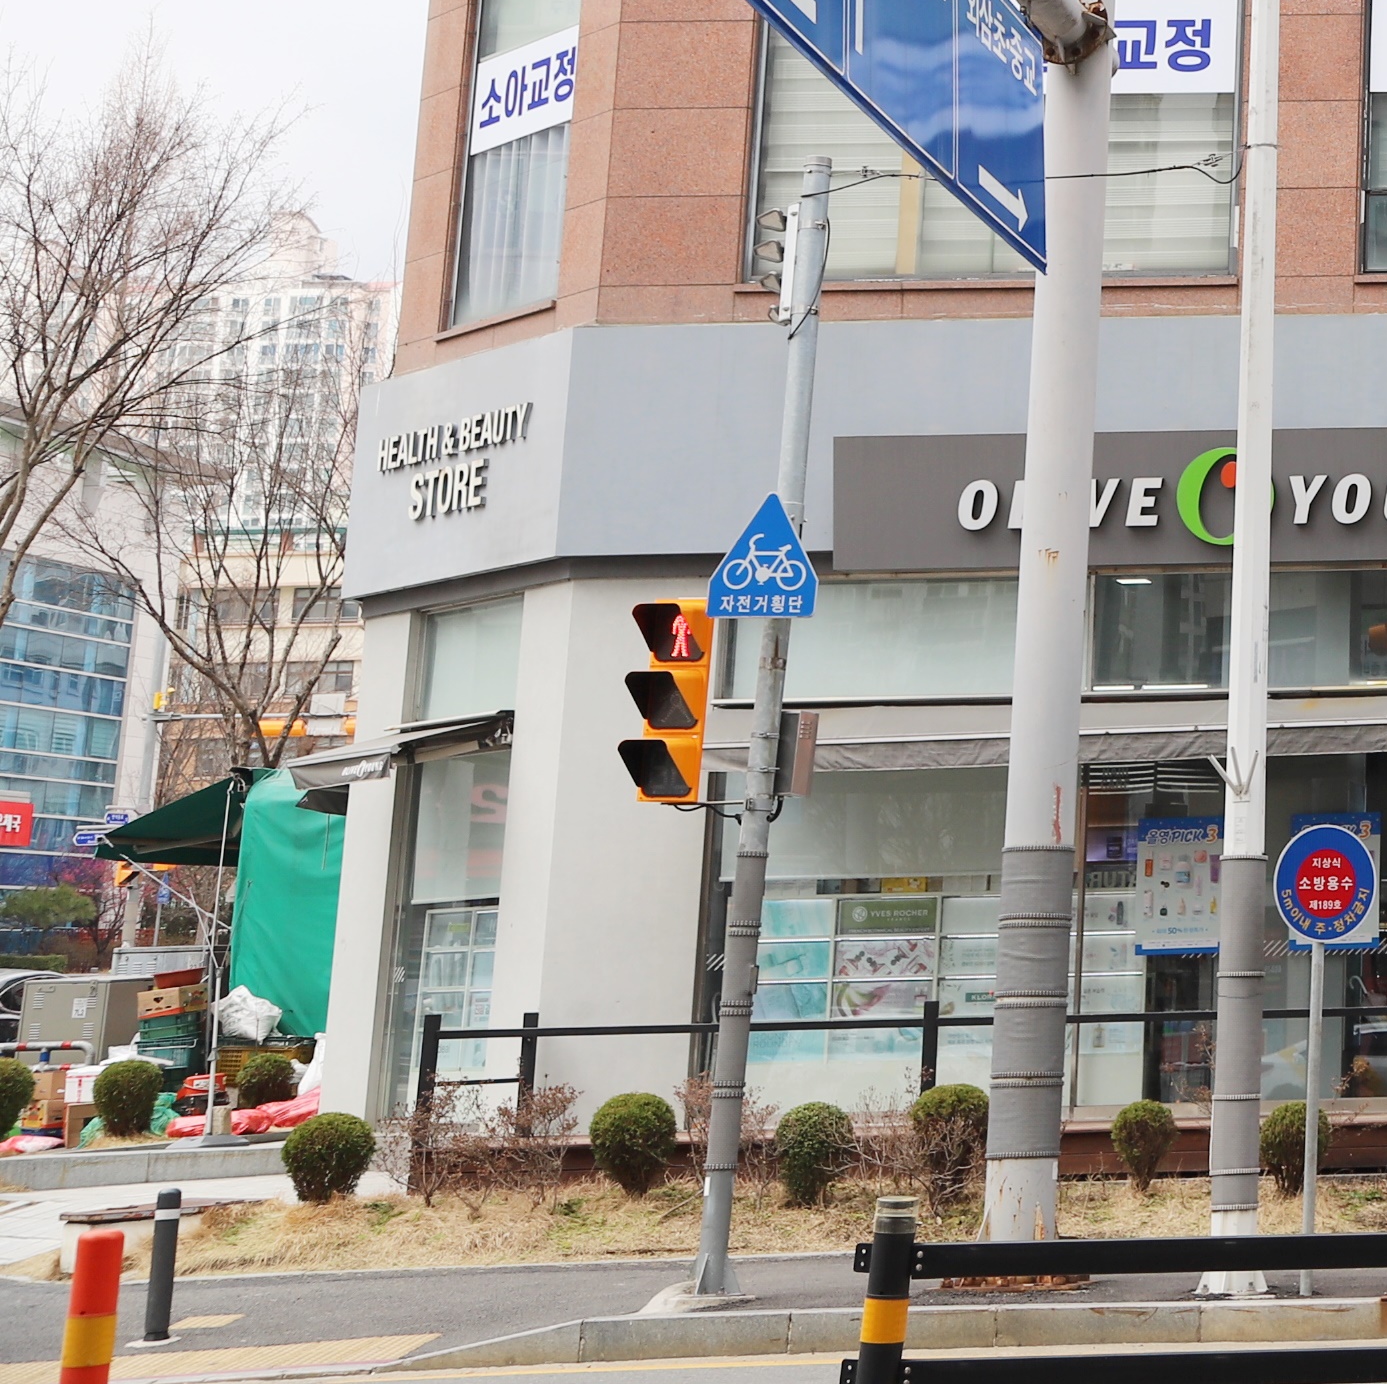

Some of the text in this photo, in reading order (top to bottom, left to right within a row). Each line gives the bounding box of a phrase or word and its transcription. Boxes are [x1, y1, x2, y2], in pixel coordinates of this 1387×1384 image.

[478, 44, 578, 130] 소아교정
[377, 425, 443, 474] HEALTH
[459, 402, 533, 454] BEAUTY
[408, 458, 490, 521] STORE
[719, 594, 803, 613] 자전거횡단
[1311, 857, 1341, 868] 지상식
[1298, 875, 1354, 891] 소방용수
[893, 908, 929, 917] ROCHER
[1308, 899, 1342, 910] 제189호
